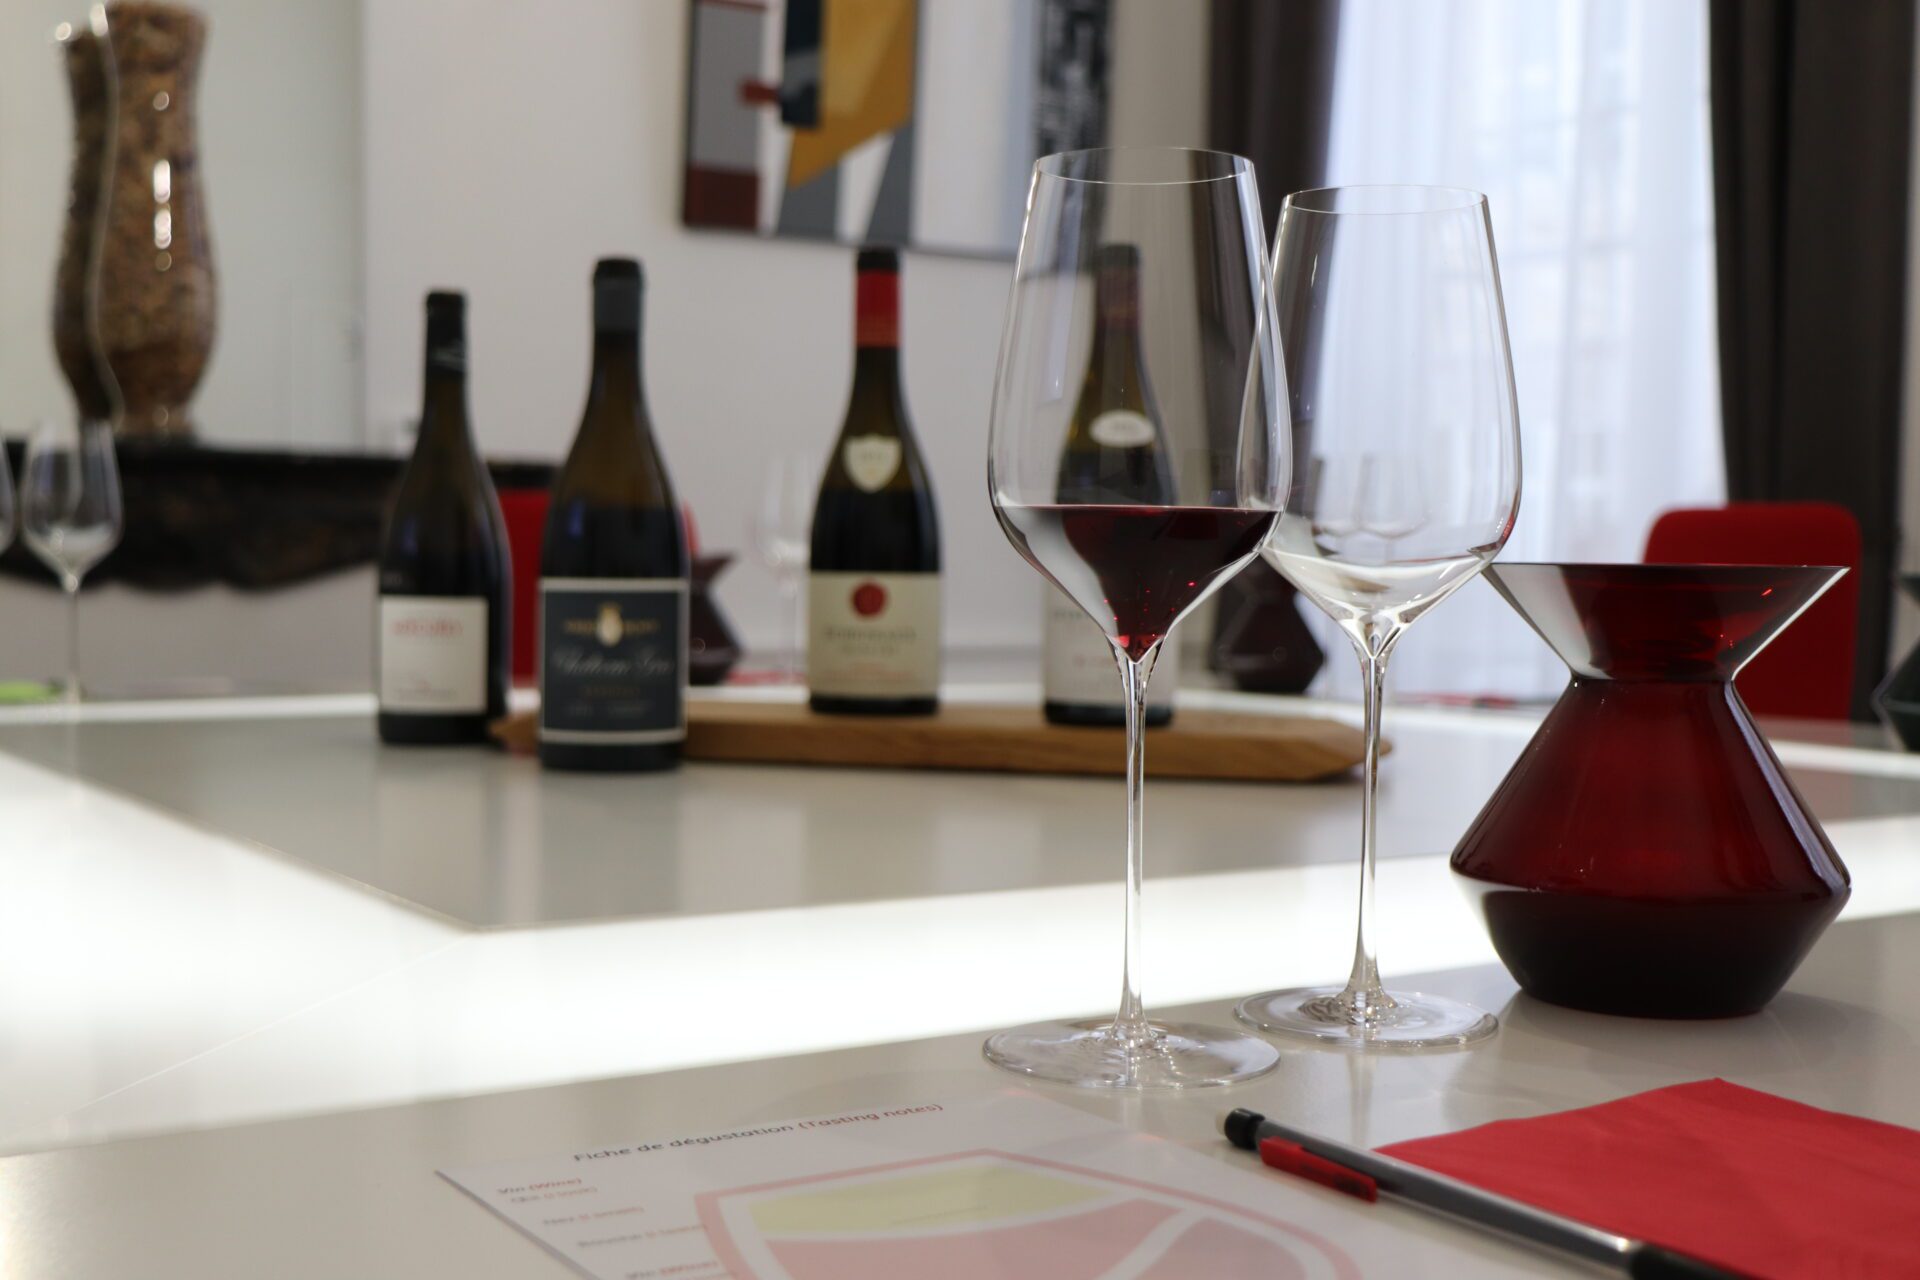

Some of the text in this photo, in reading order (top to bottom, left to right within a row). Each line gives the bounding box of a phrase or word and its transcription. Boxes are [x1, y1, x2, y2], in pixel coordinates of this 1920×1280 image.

[573, 1103, 945, 1163] Fiche de dégustation (Tasting notes)
